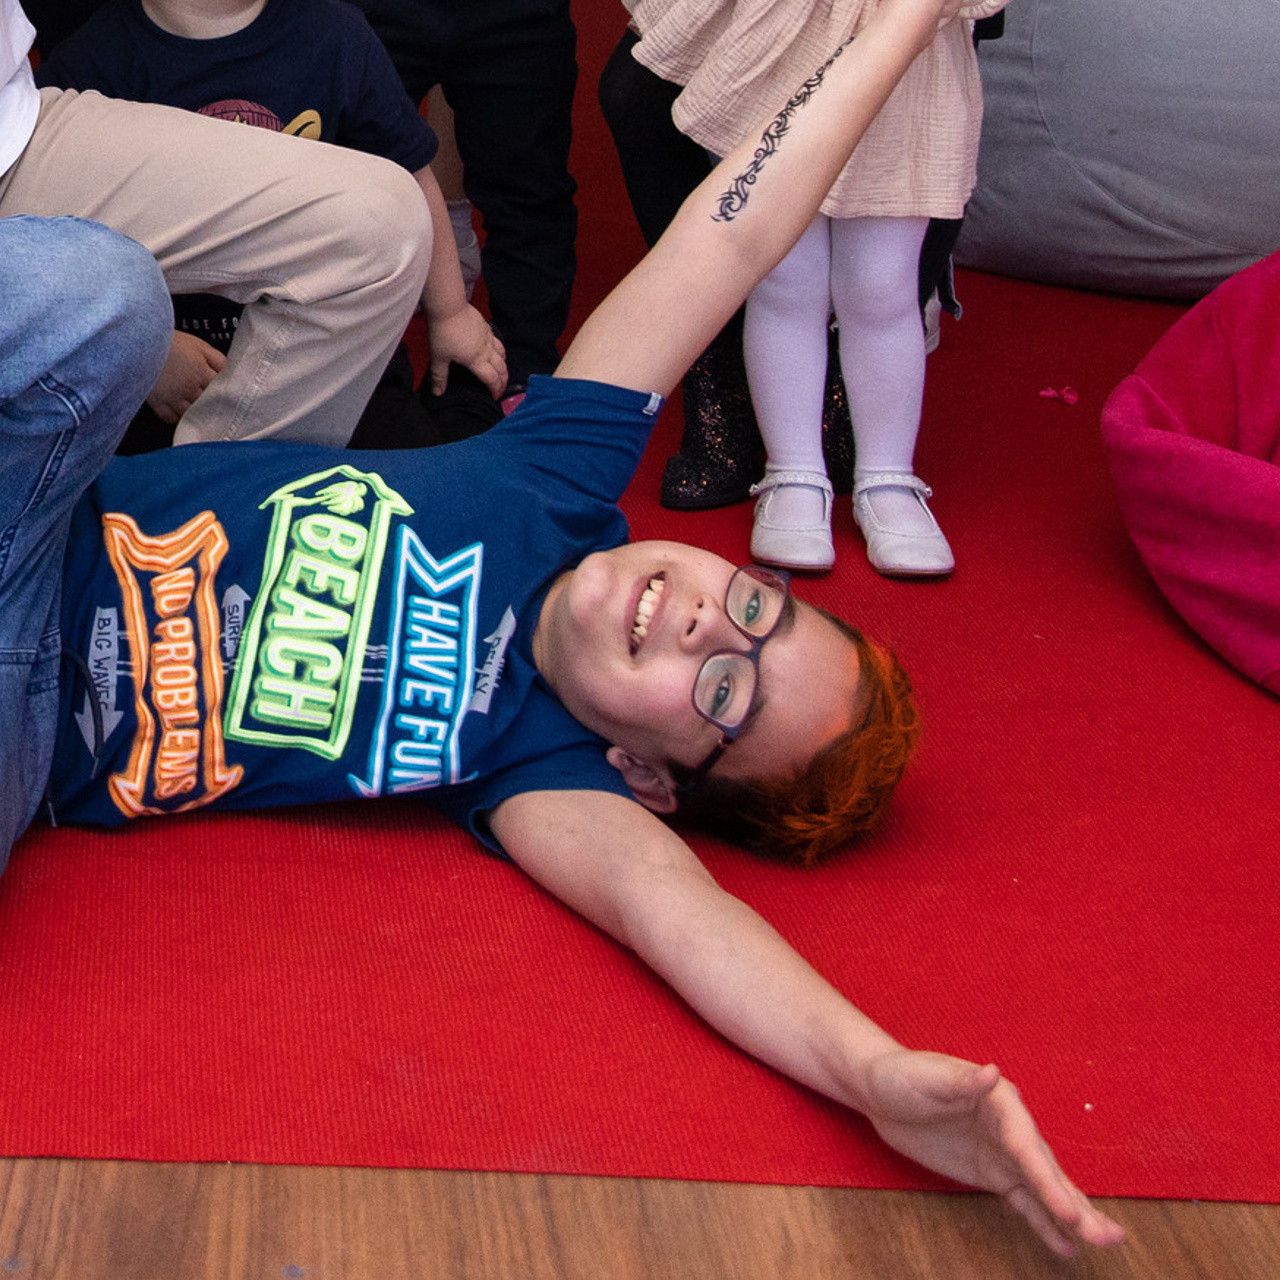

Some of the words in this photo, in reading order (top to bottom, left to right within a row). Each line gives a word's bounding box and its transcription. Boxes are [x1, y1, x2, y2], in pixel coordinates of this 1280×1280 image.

[95, 617, 111, 651] BIG
[150, 567, 195, 618] NO
[250, 512, 368, 729] BEACH
[400, 594, 458, 715] HAVE
[151, 618, 200, 799] PROBLEMS
[387, 713, 449, 794] FUN
